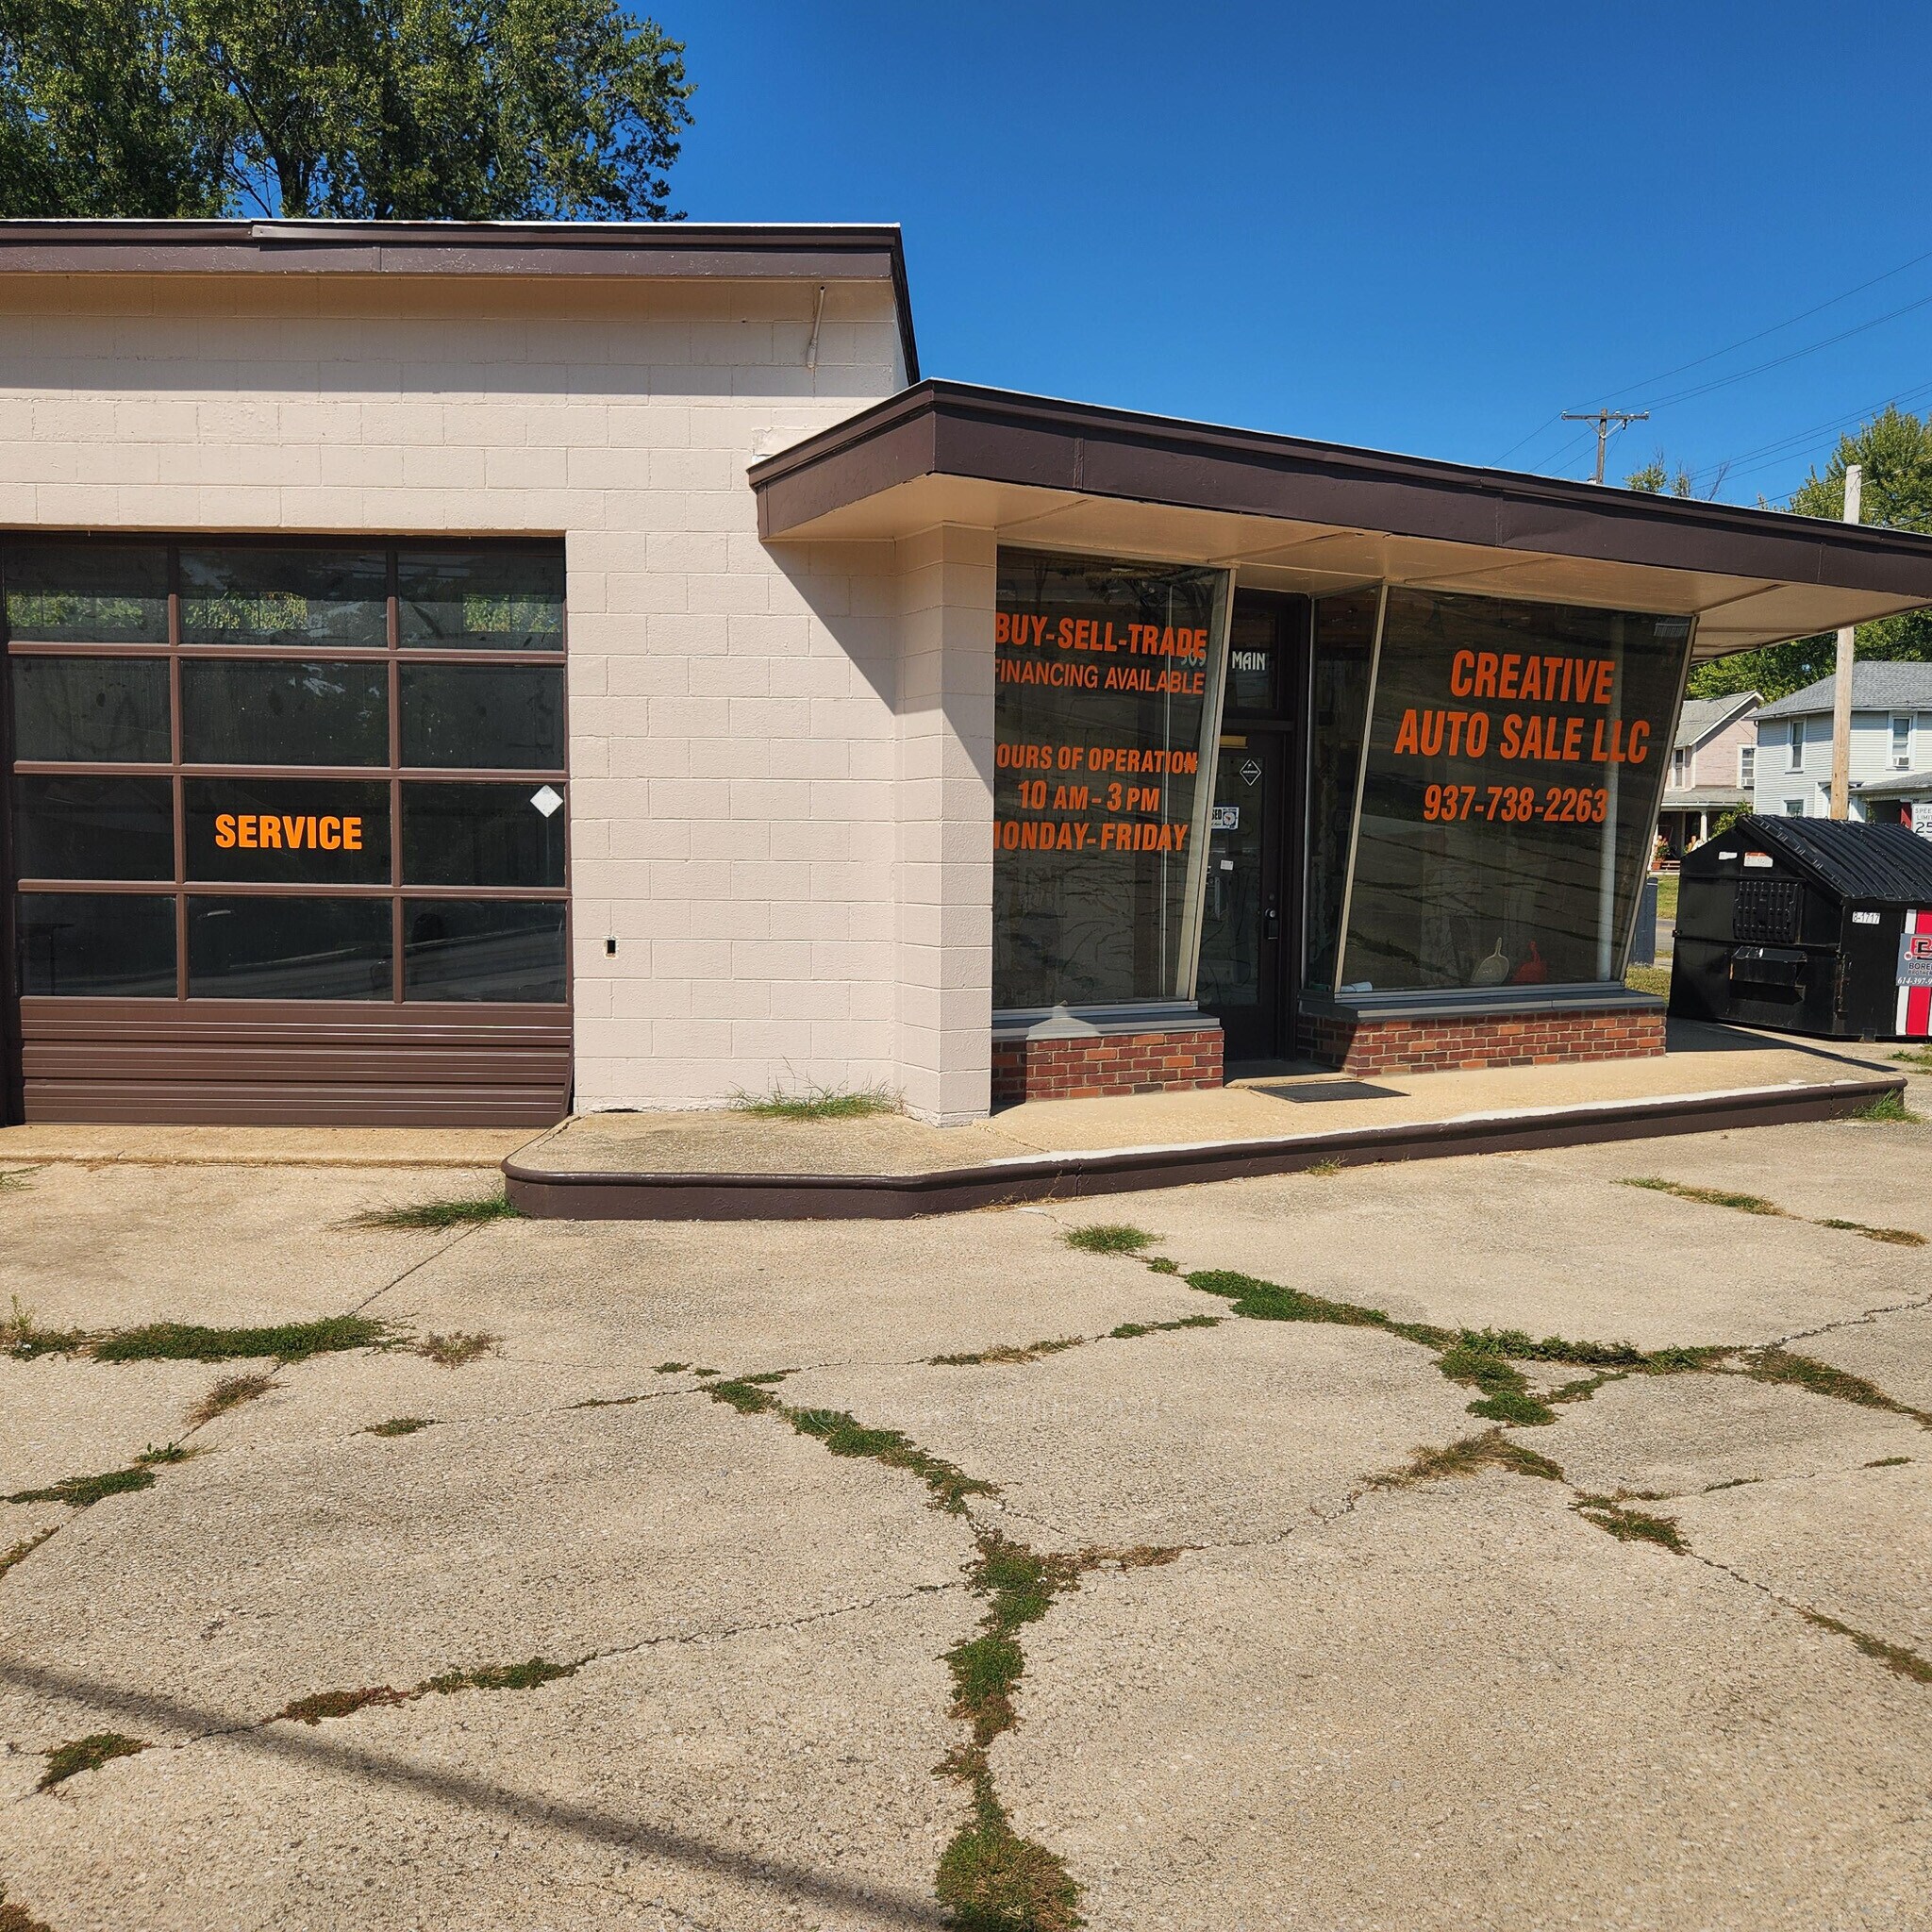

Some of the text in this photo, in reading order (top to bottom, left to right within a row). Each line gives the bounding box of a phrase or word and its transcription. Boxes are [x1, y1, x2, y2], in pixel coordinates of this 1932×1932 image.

[995, 612, 1208, 658] BUY-SELL-TRADE
[1231, 651, 1266, 671] MAIN
[1450, 649, 1615, 705] CREATIVE
[1104, 667, 1205, 695] AVAILABLE
[1393, 708, 1650, 764] AUTO SALE LLC
[1058, 746, 1084, 771] OF
[1088, 747, 1198, 774] OPERATION
[1018, 780, 1047, 810] 10
[1053, 785, 1089, 810] AM
[1107, 782, 1123, 811] 3
[1125, 787, 1160, 812] PM
[1424, 784, 1609, 823] 937-738-2263
[215, 813, 363, 850] SERVICE
[1908, 962, 1932, 971] BORE
